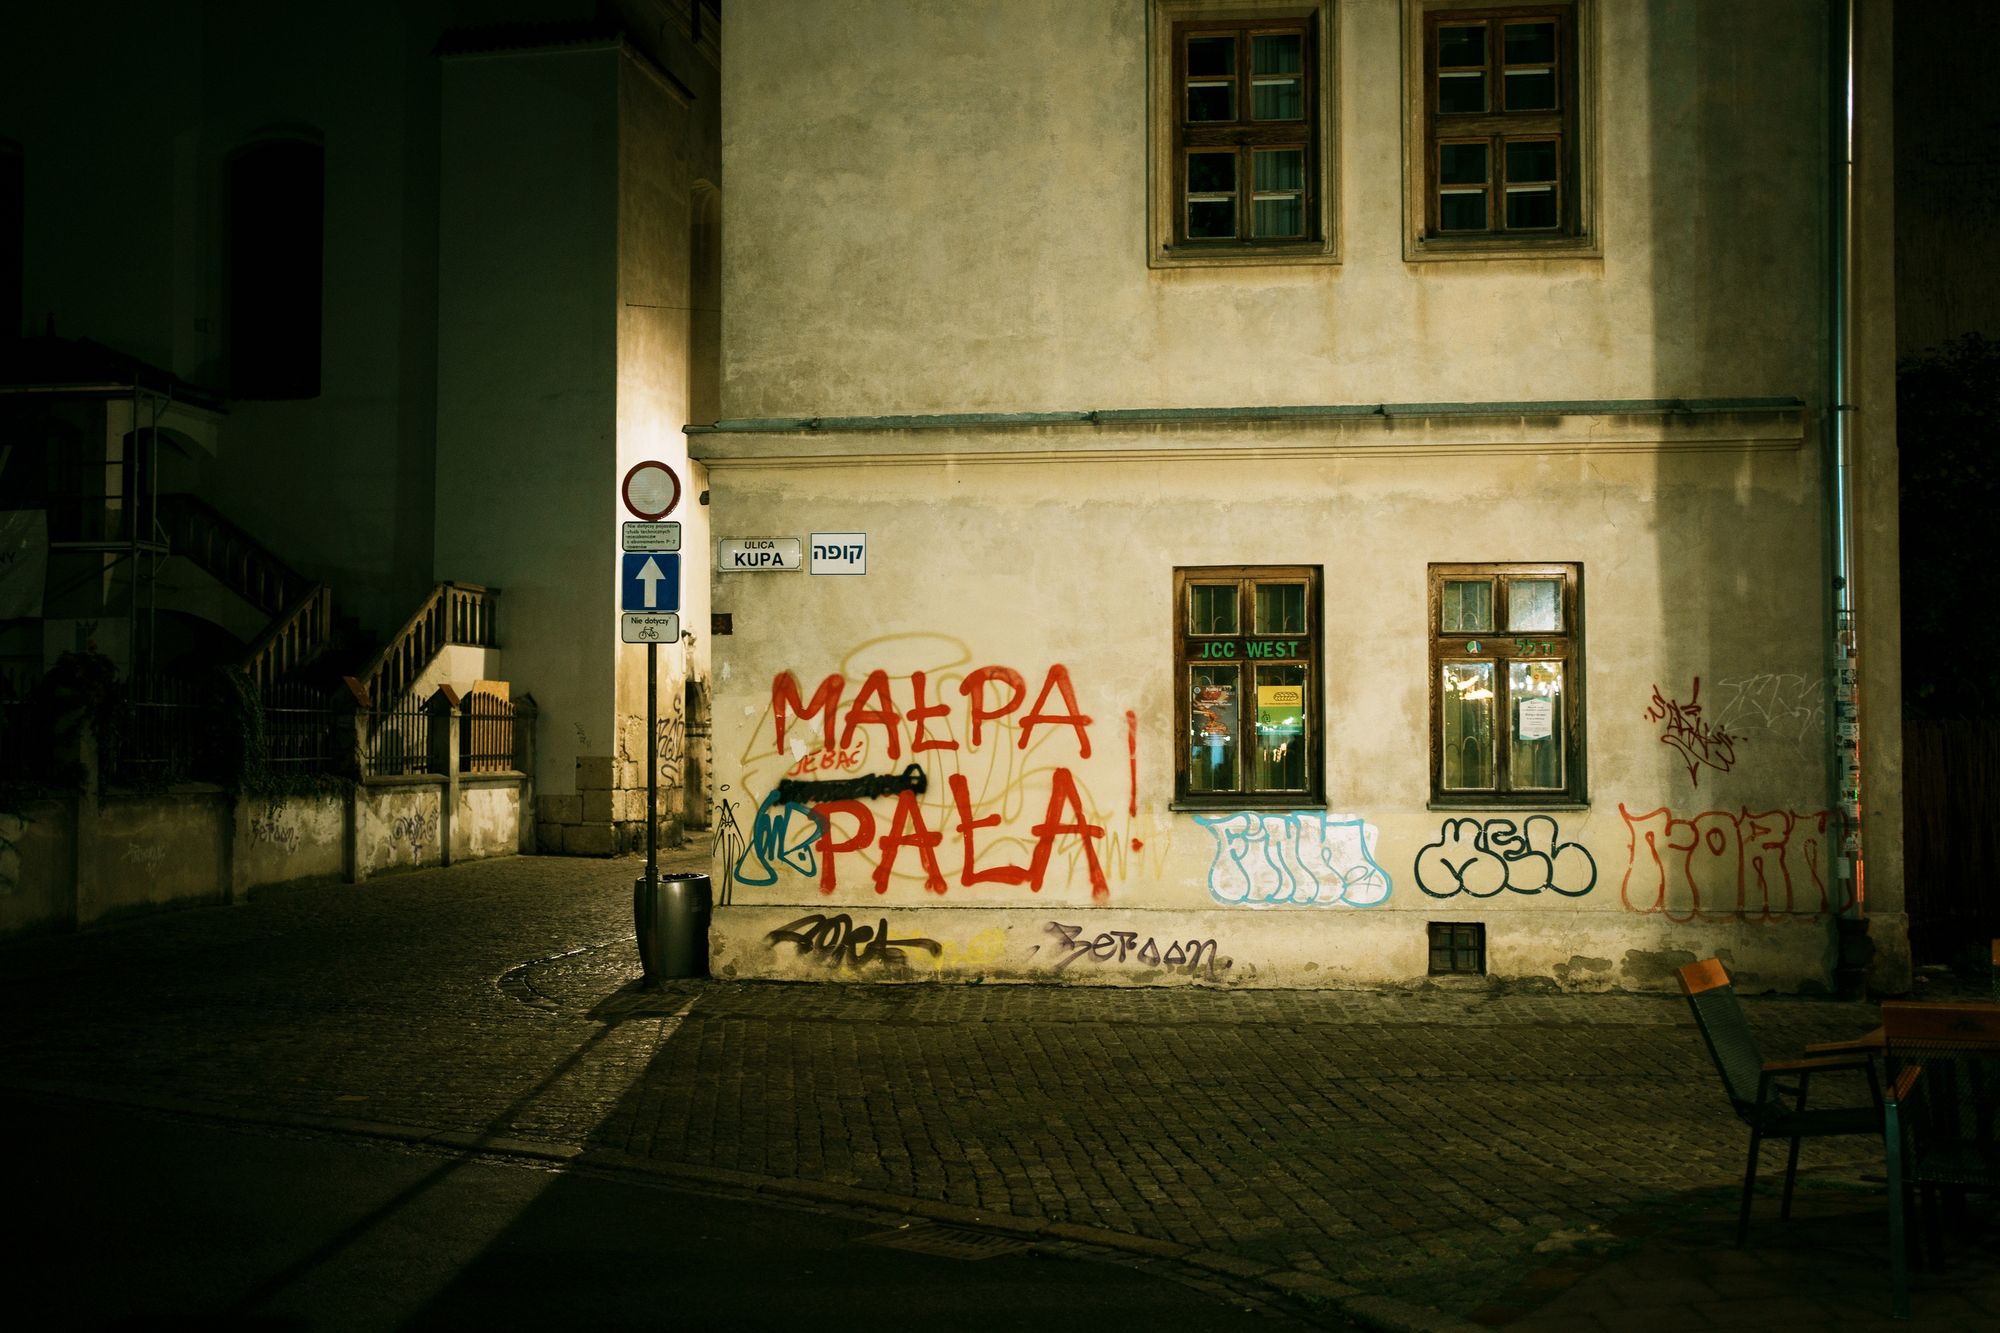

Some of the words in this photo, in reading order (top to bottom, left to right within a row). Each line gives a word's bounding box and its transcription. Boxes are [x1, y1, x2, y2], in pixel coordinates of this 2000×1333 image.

[744, 541, 775, 549] ULICA
[735, 553, 784, 567] KUPA
[813, 545, 864, 564] קופה
[631, 616, 643, 624] Nie
[645, 617, 669, 626] dotyczy
[1202, 642, 1235, 658] JCC
[1246, 641, 1298, 658] WEST
[771, 663, 1093, 760] MAŁPA
